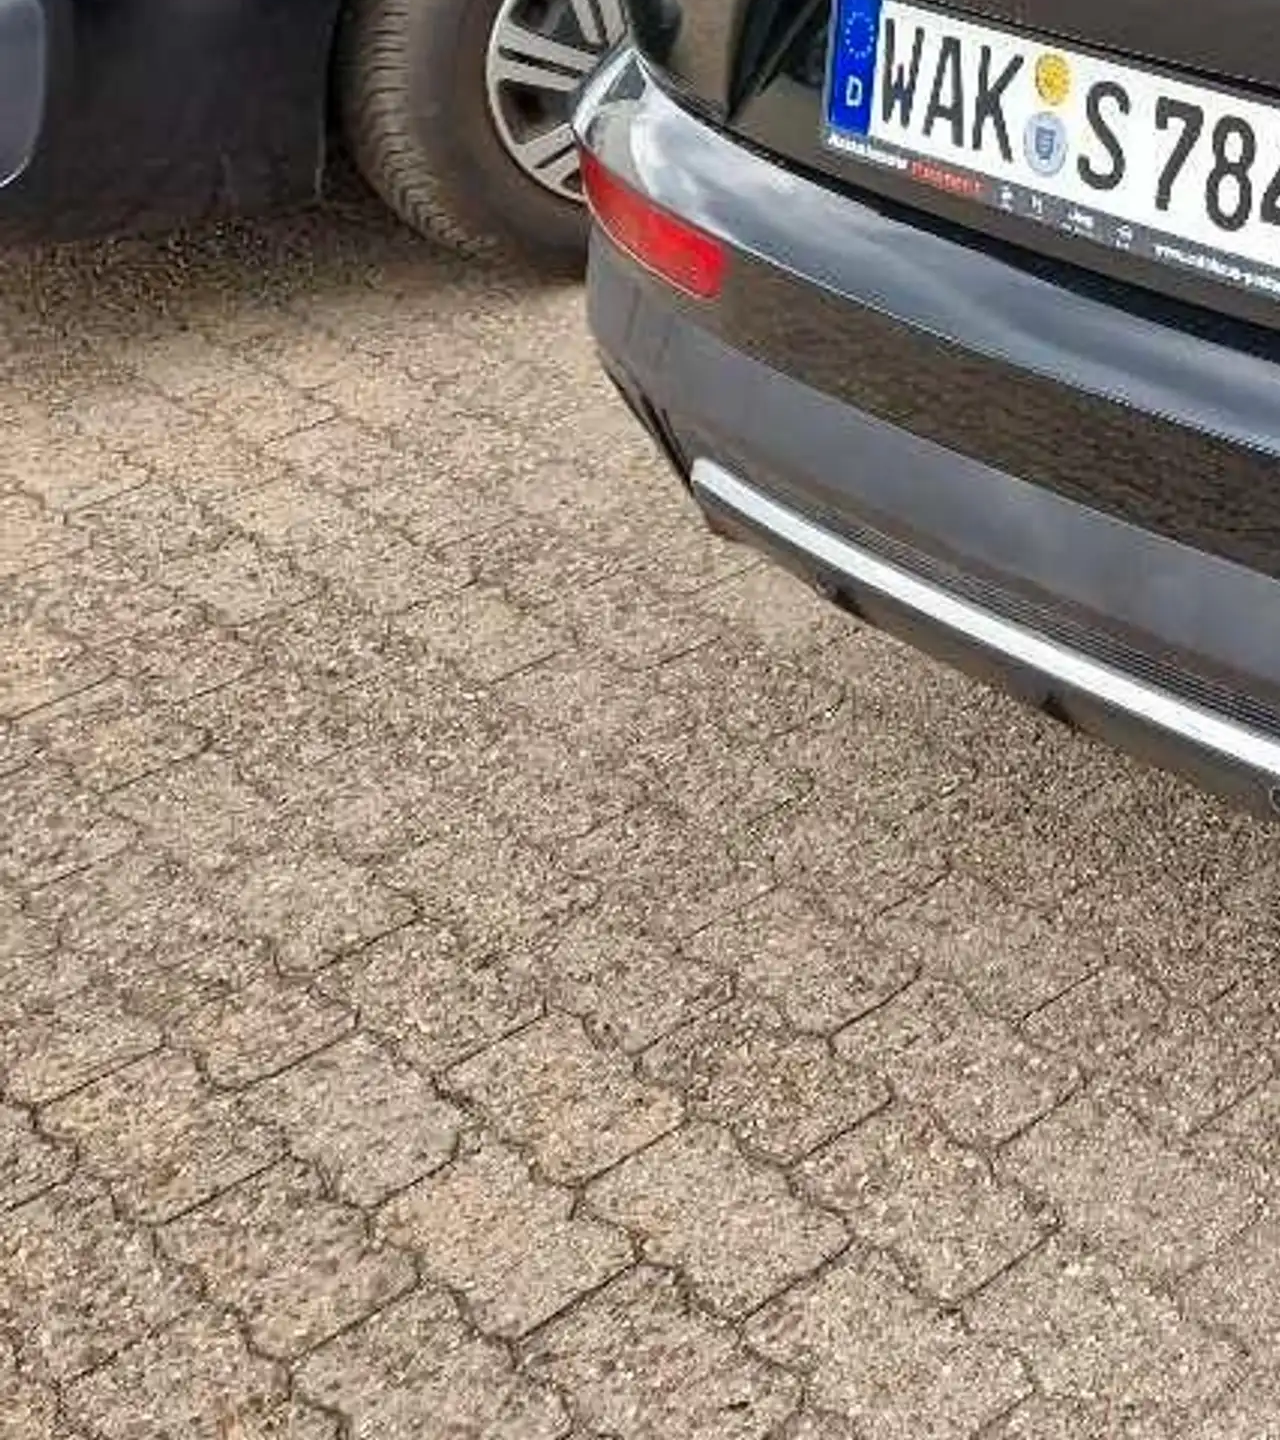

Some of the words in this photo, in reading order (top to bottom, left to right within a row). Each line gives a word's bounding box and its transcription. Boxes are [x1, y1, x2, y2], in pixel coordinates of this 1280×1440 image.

[844, 74, 863, 108] D
[881, 16, 1025, 163] WAK
[1076, 81, 1132, 192] S
